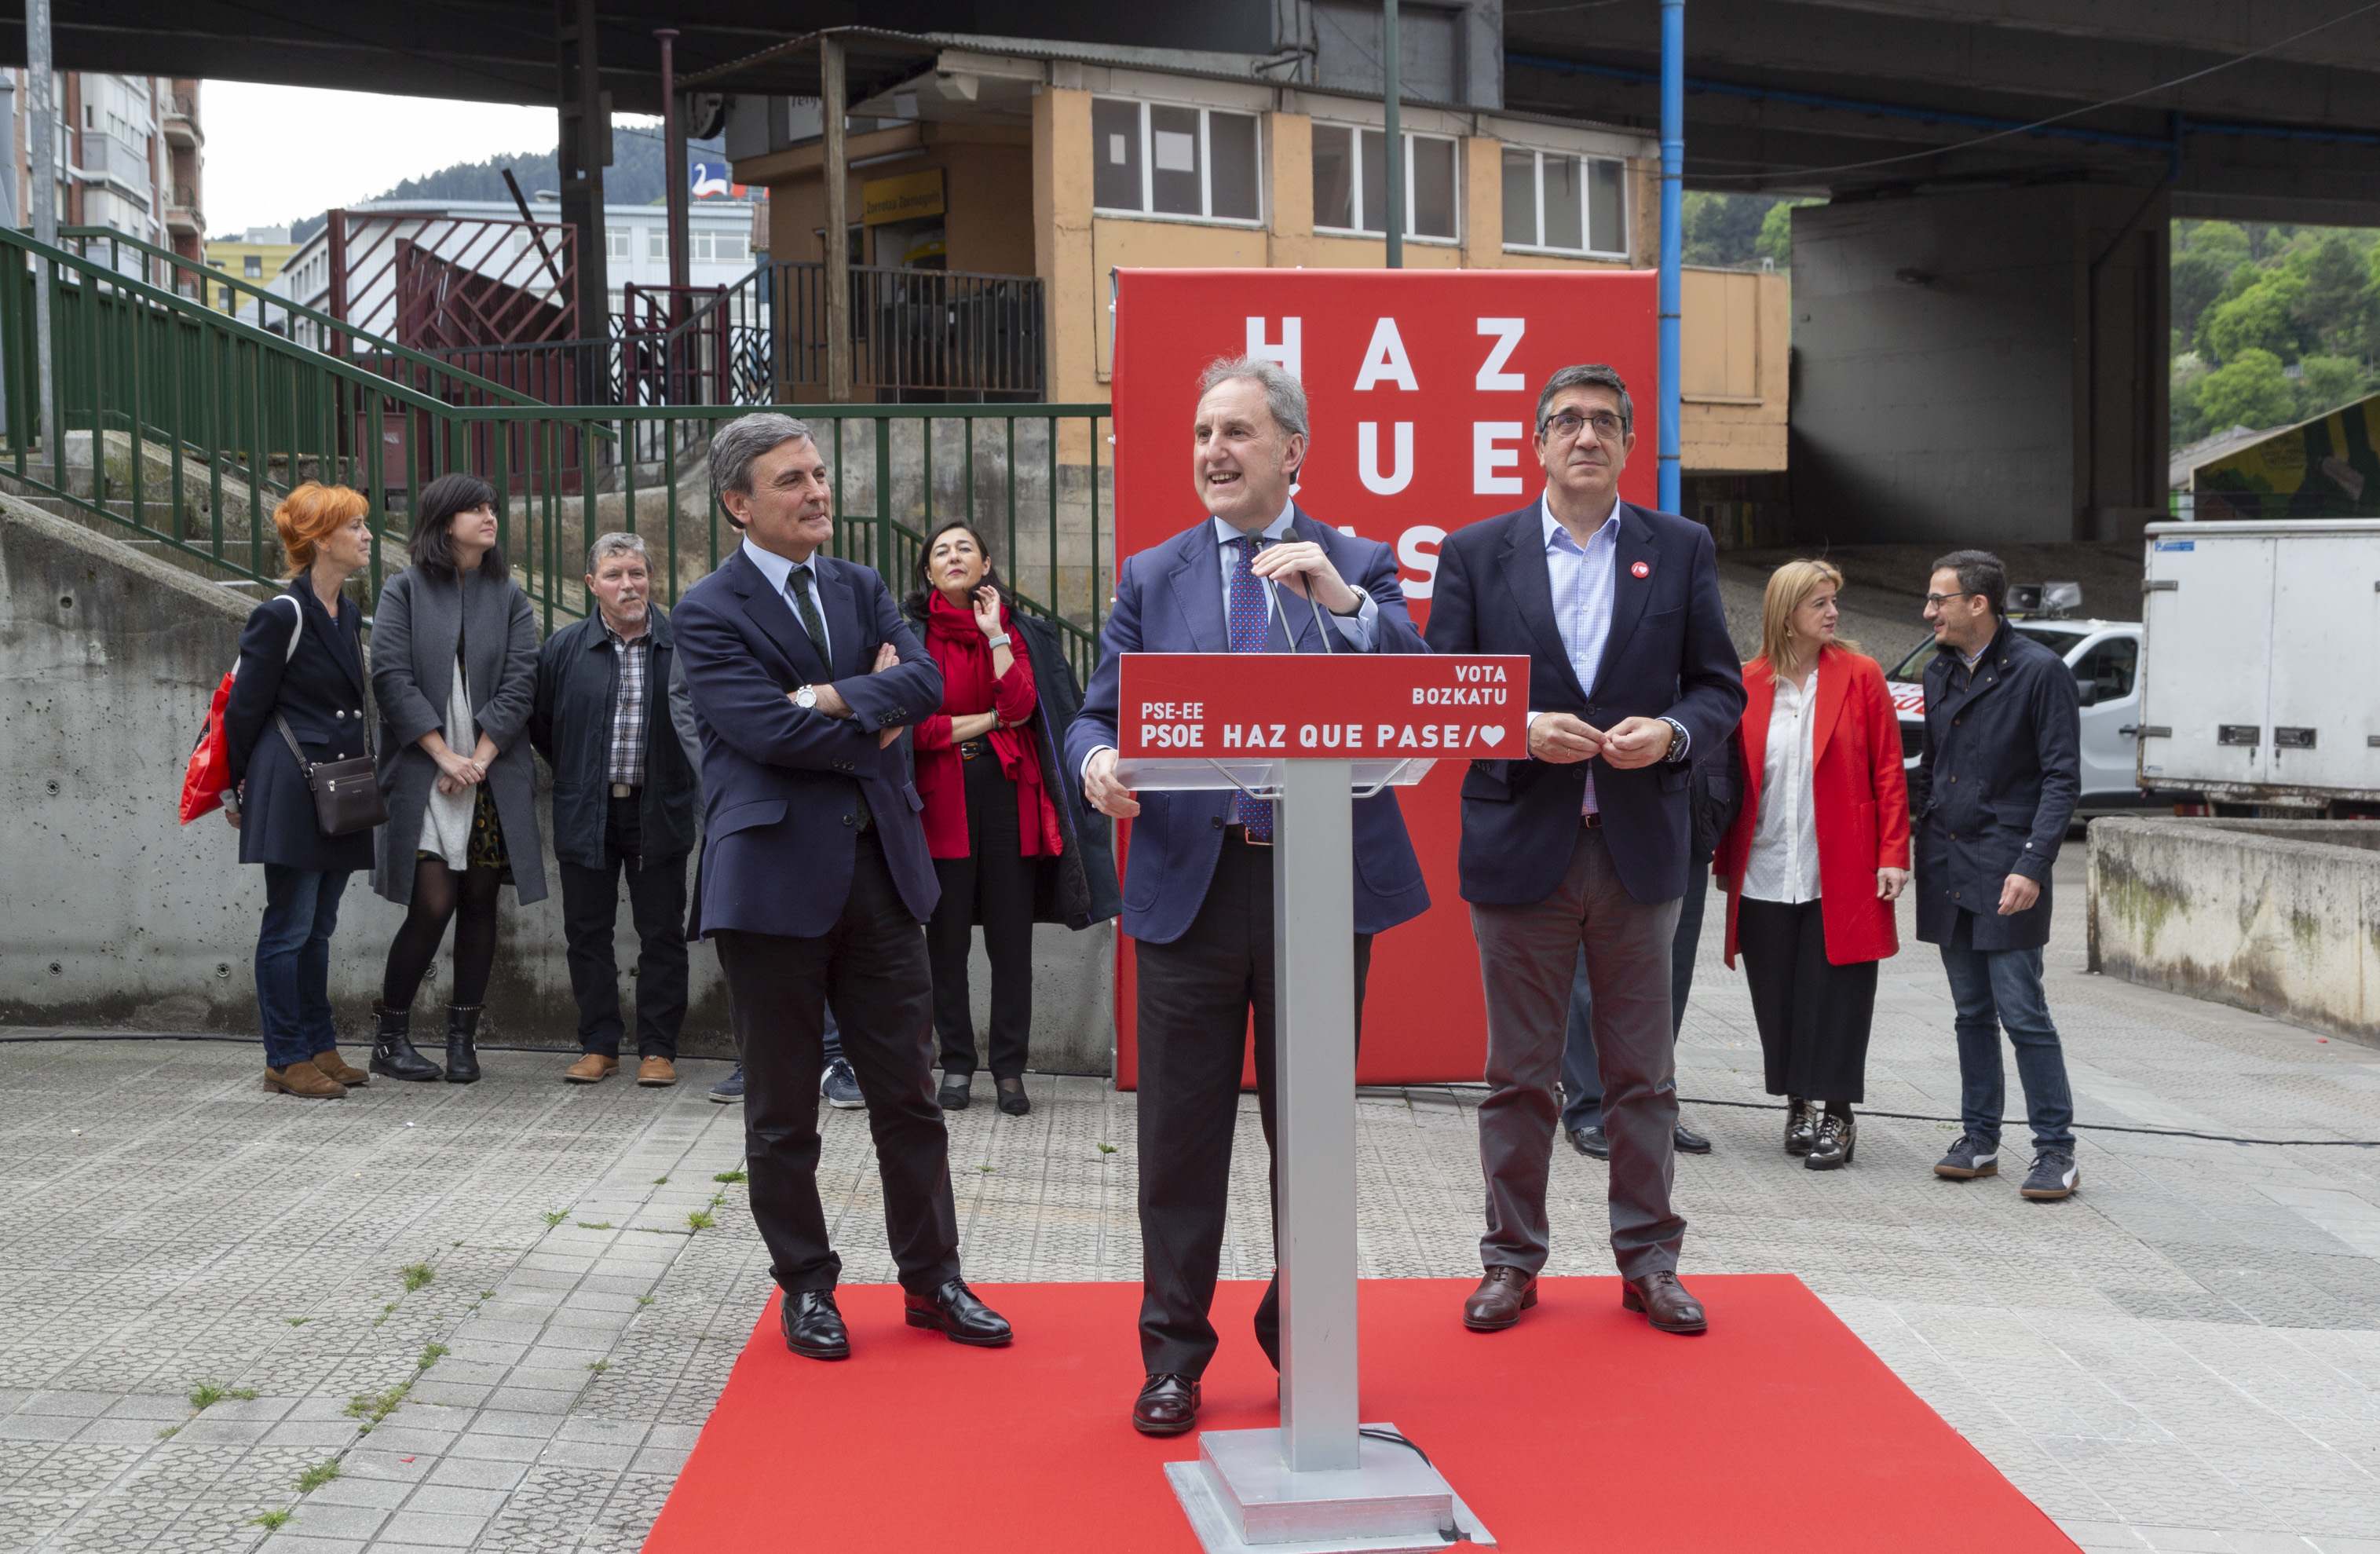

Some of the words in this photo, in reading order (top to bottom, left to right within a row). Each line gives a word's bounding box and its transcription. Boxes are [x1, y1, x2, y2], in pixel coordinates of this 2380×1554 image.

[1245, 316, 1526, 392] HAZ
[1455, 665, 1507, 682] VOTA
[1412, 687, 1507, 705] BOZKATU
[1142, 702, 1204, 720] PSE-EE
[1141, 724, 1204, 748] PSOE
[1223, 724, 1286, 748] HAZ
[1300, 724, 1362, 748] QUE
